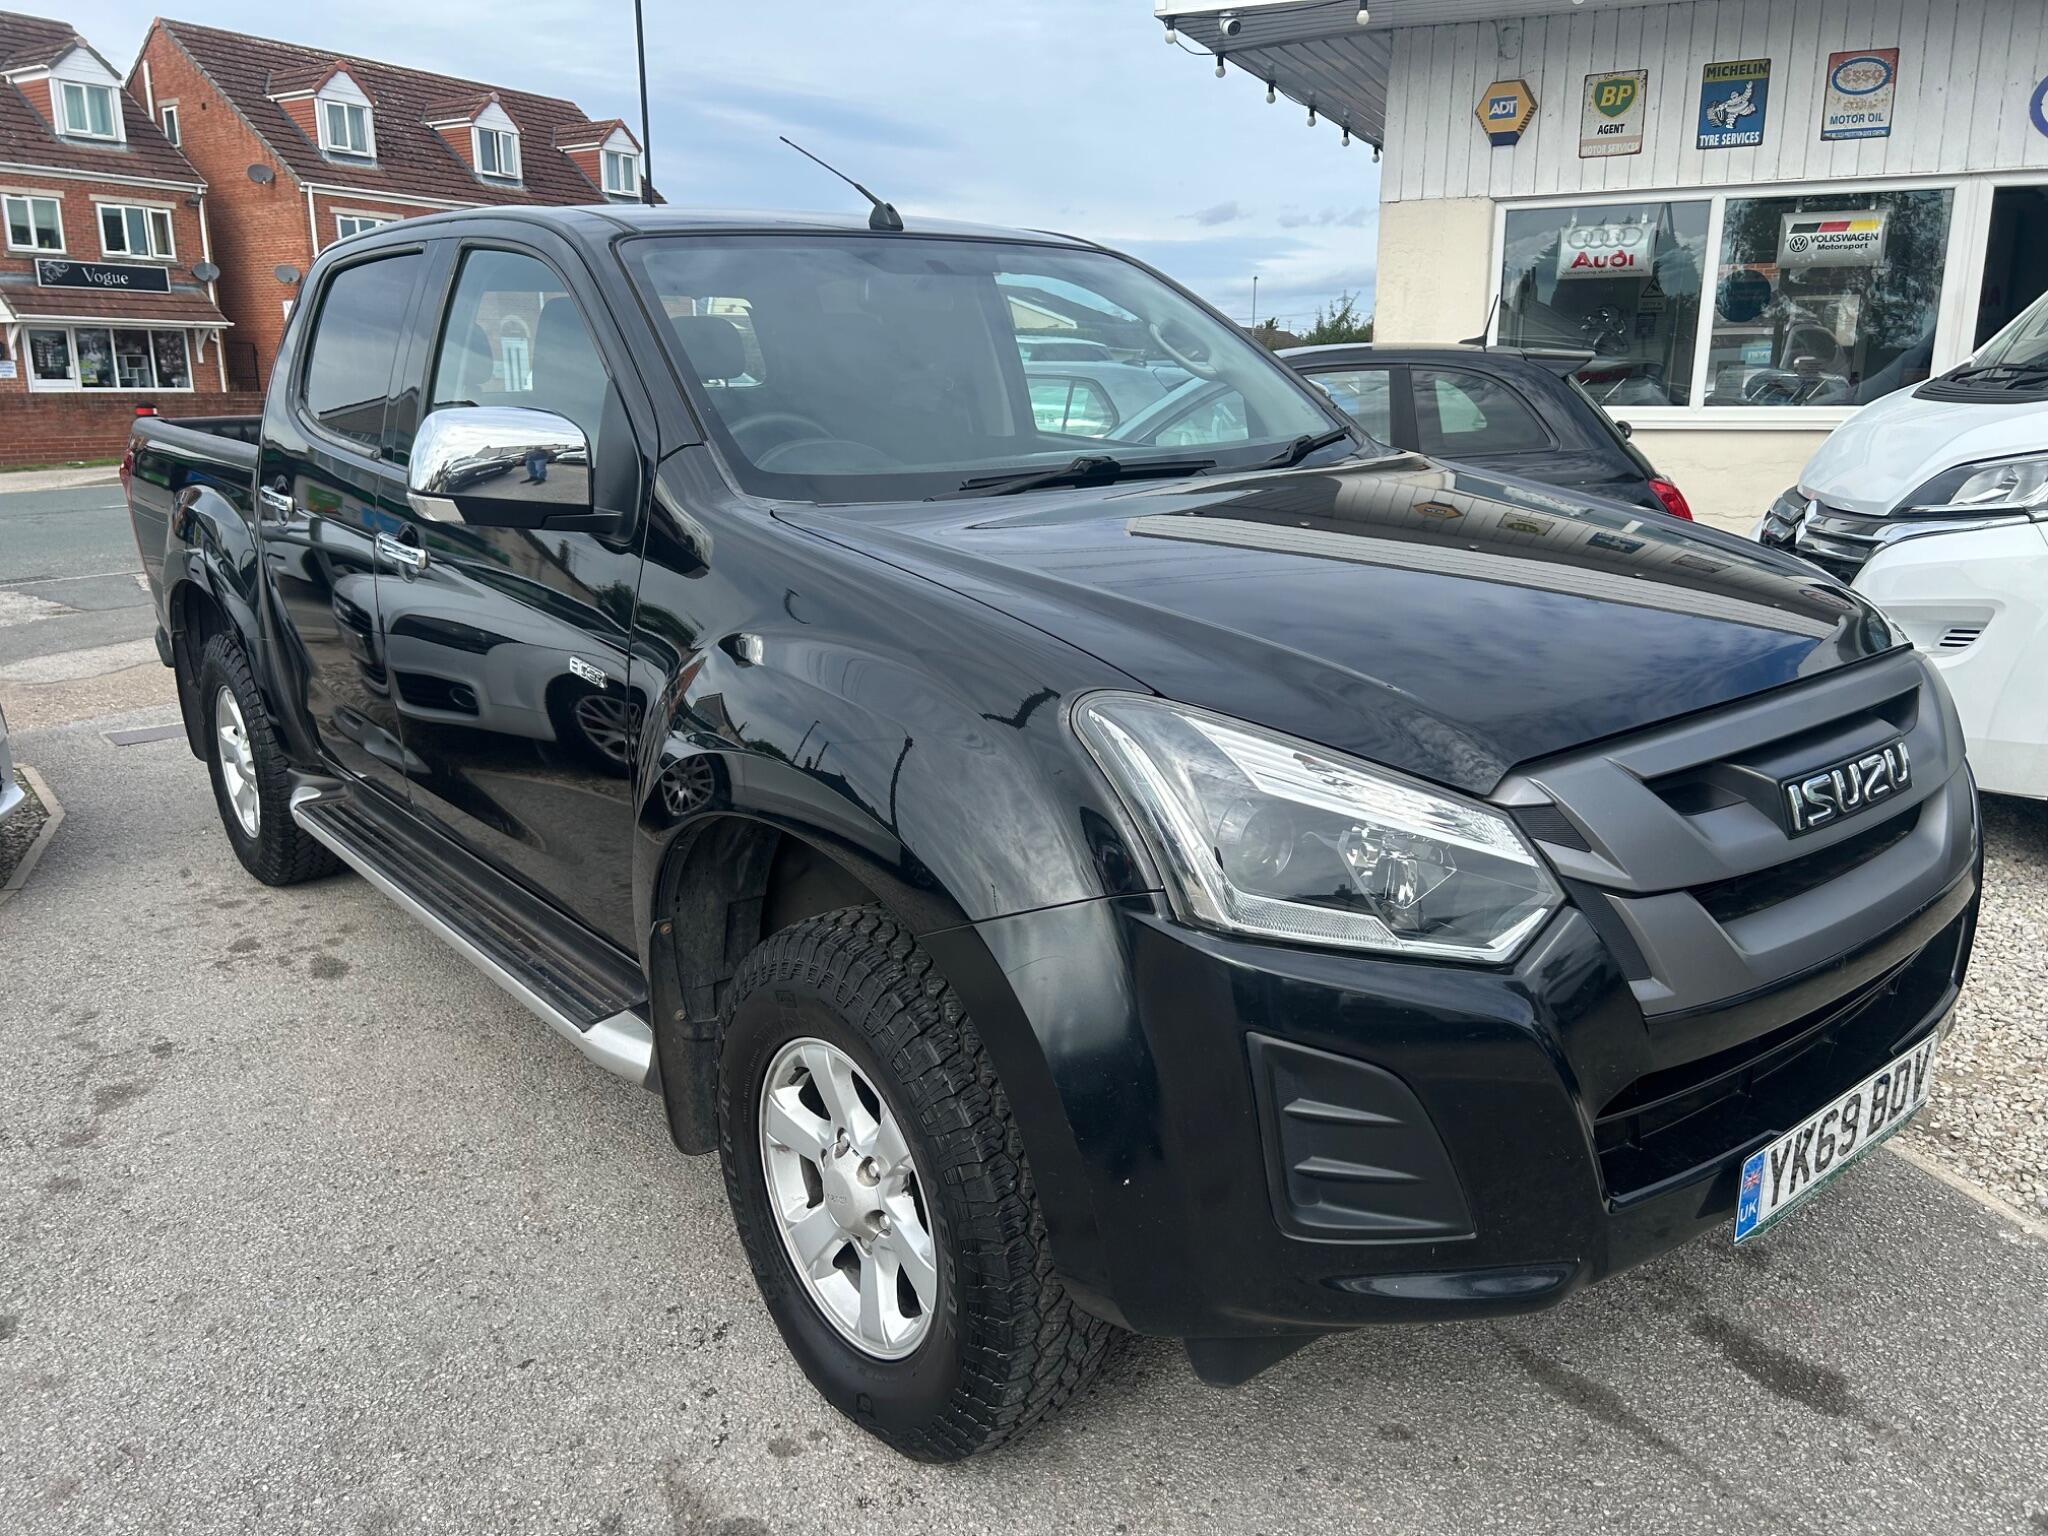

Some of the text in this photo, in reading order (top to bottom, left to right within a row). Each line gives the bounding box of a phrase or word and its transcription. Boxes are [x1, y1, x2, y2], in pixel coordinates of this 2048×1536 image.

[1706, 63, 1768, 78] MICHELIN
[1600, 85, 1633, 107] BP
[1489, 100, 1517, 116] ADT
[1829, 113, 1884, 125] MOTOR OIL
[1597, 123, 1625, 135] AGENT
[1700, 131, 1760, 147] TYRE SERVICES
[1810, 232, 1879, 243] VOLKSWAGEN
[1816, 242, 1868, 251] Motorsport
[1570, 249, 1634, 268] Audi
[81, 267, 129, 286] Vogue
[1788, 742, 1912, 831] ISUZU
[1770, 1093, 1861, 1208] YK69
[1740, 1201, 1757, 1223] UK
